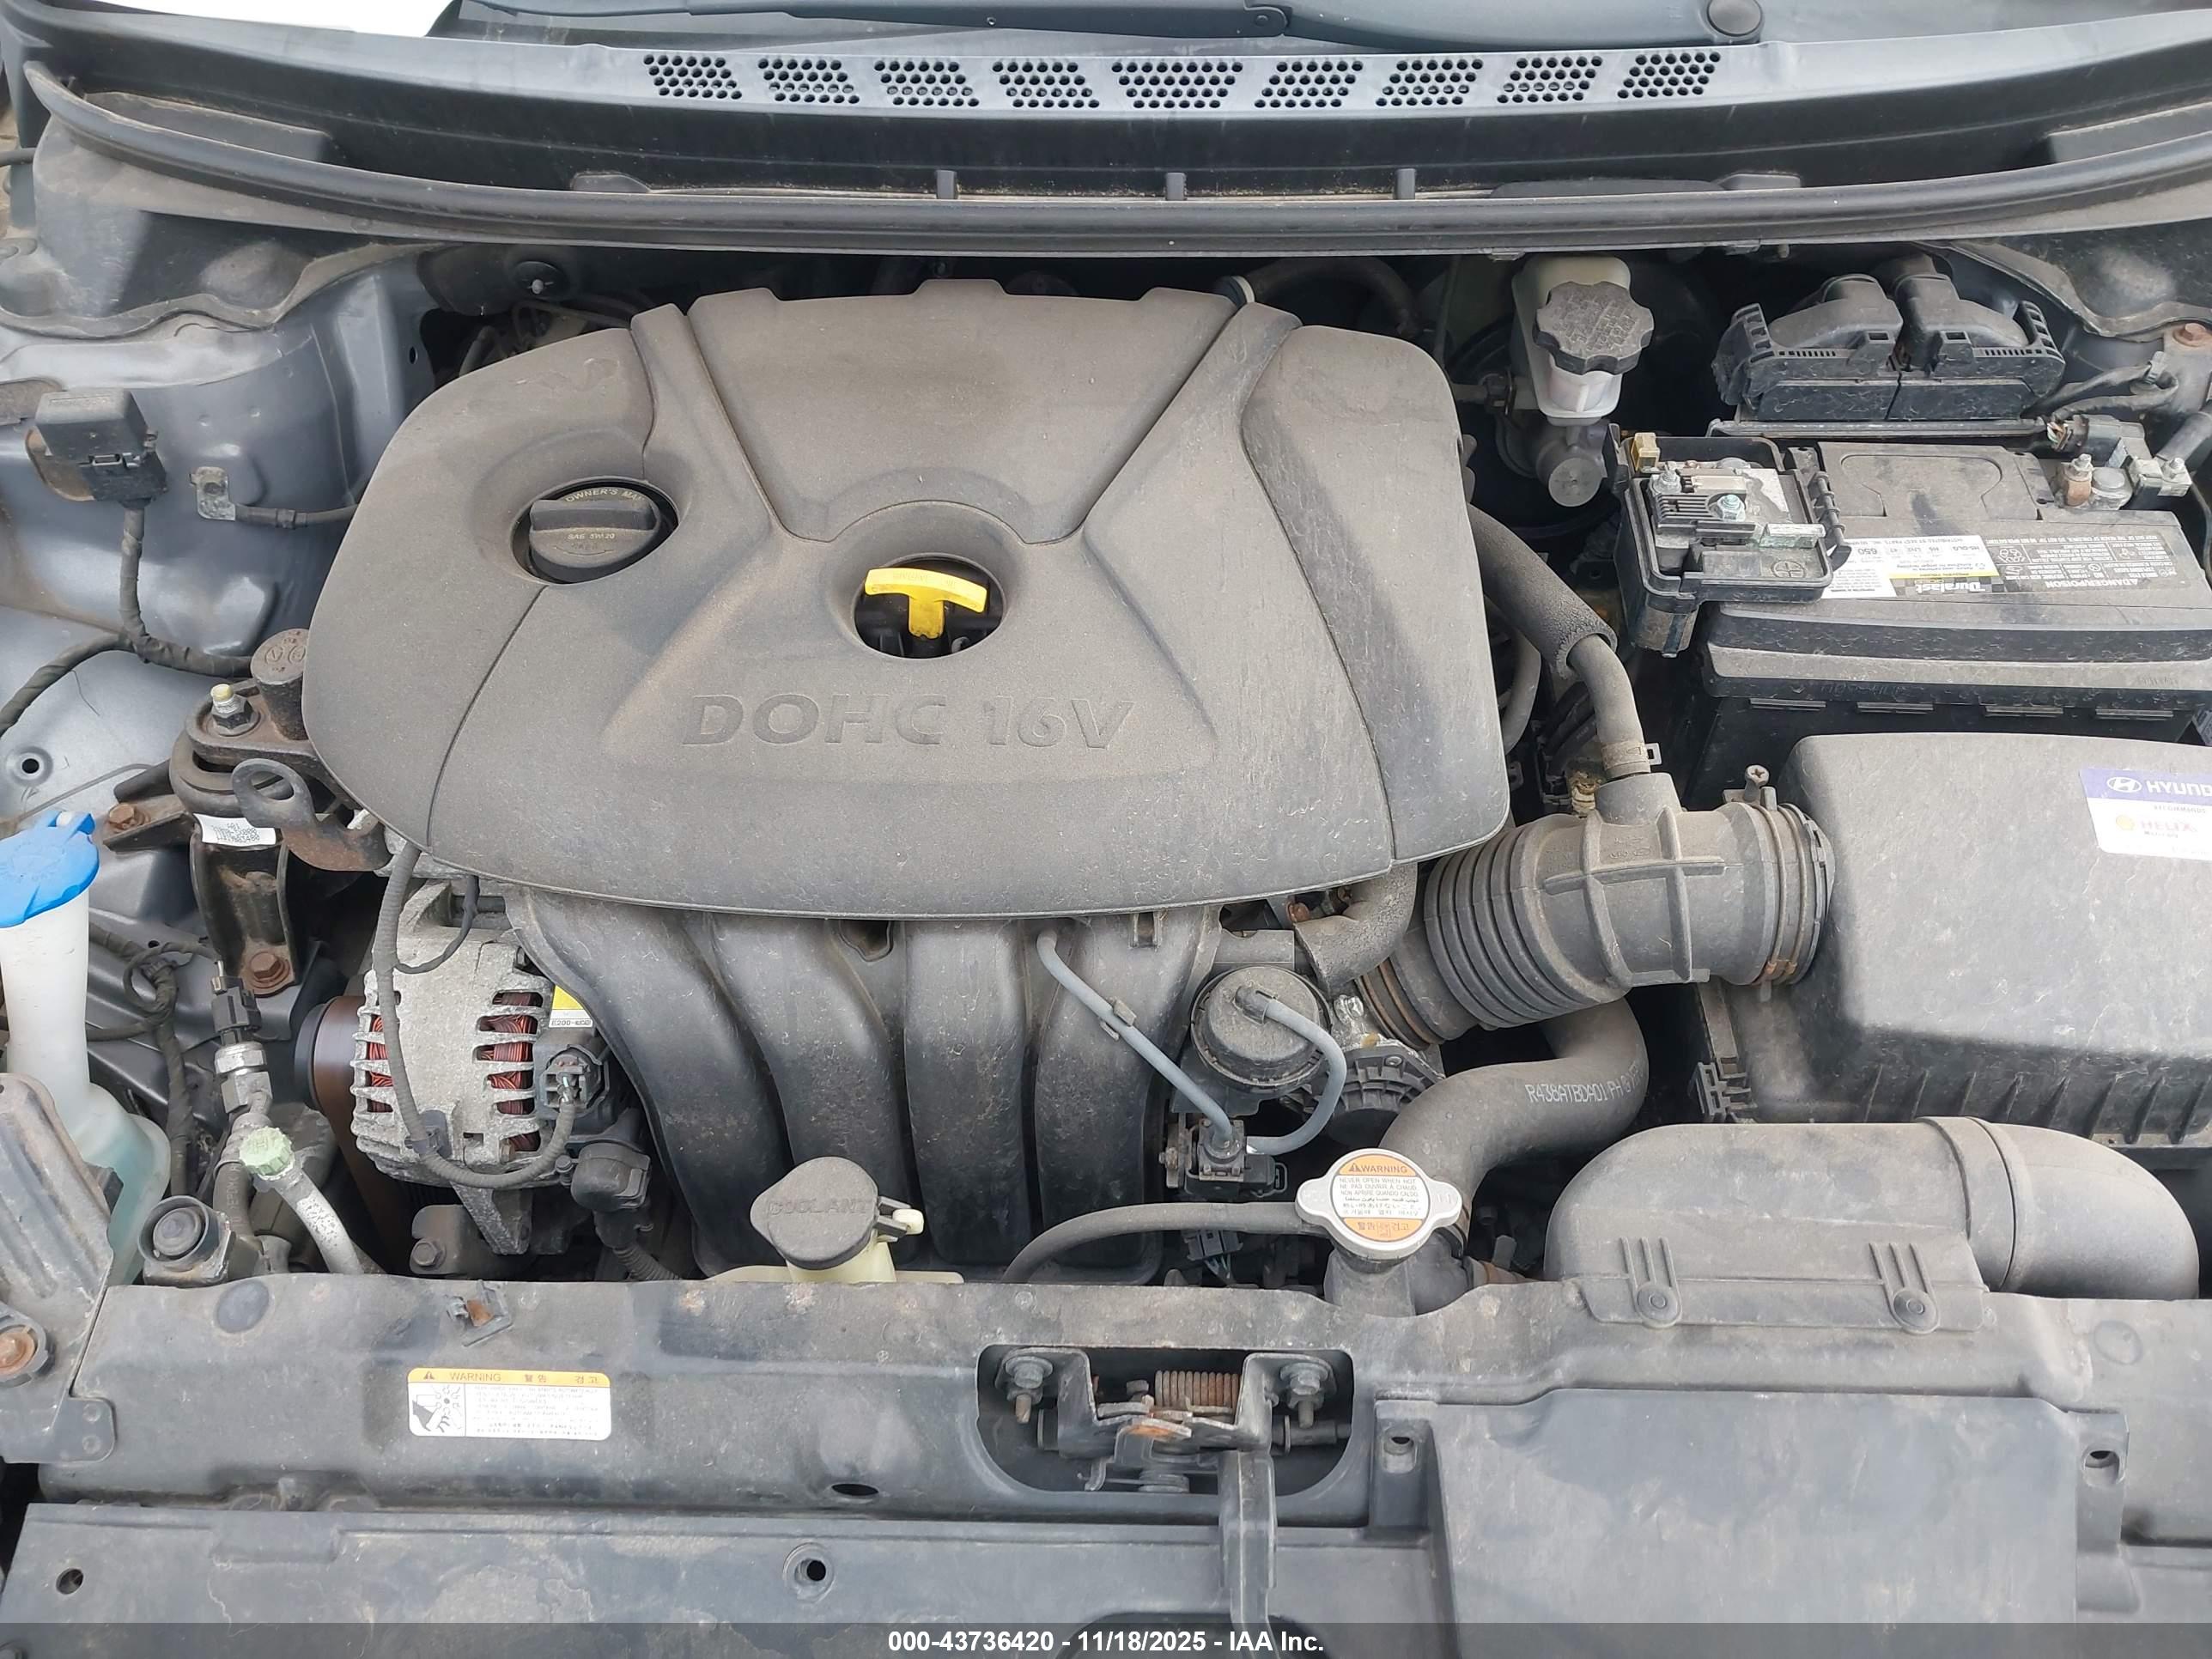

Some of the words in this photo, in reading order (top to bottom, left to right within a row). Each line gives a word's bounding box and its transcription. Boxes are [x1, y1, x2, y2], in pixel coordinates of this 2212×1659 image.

[565, 488, 619, 502] OWNER'S
[1915, 582, 1986, 594] Duralast
[682, 693, 946, 745] DOHC
[983, 695, 1136, 749] 16V
[1361, 1164, 1408, 1174] WARNING
[769, 1198, 866, 1216] COOLANT
[449, 1371, 501, 1382] WARNING
